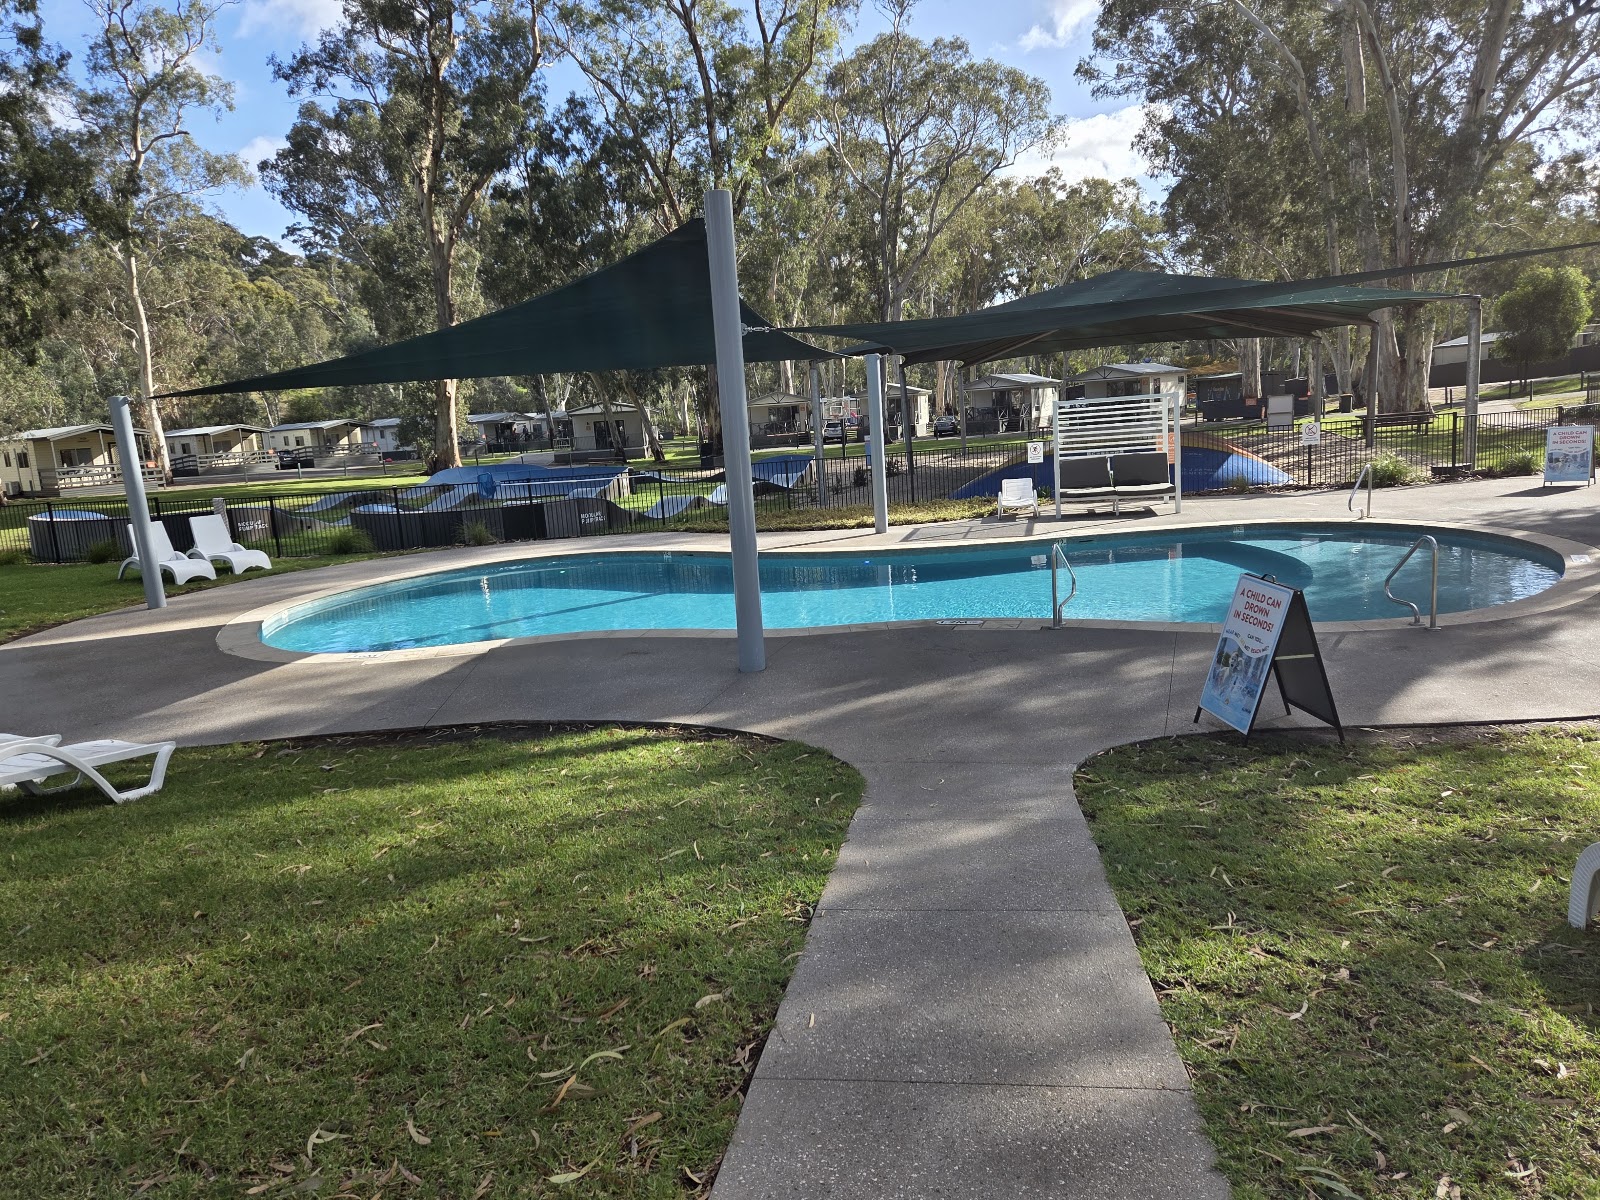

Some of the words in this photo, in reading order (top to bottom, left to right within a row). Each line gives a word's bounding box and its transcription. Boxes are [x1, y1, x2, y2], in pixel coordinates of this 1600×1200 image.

[1240, 588, 1246, 597] A
[1246, 590, 1266, 603] CHILD
[1266, 597, 1282, 609] CAN
[1244, 601, 1270, 618] DROWN
[1233, 609, 1241, 619] IN
[1241, 612, 1274, 632] SECONDS!
